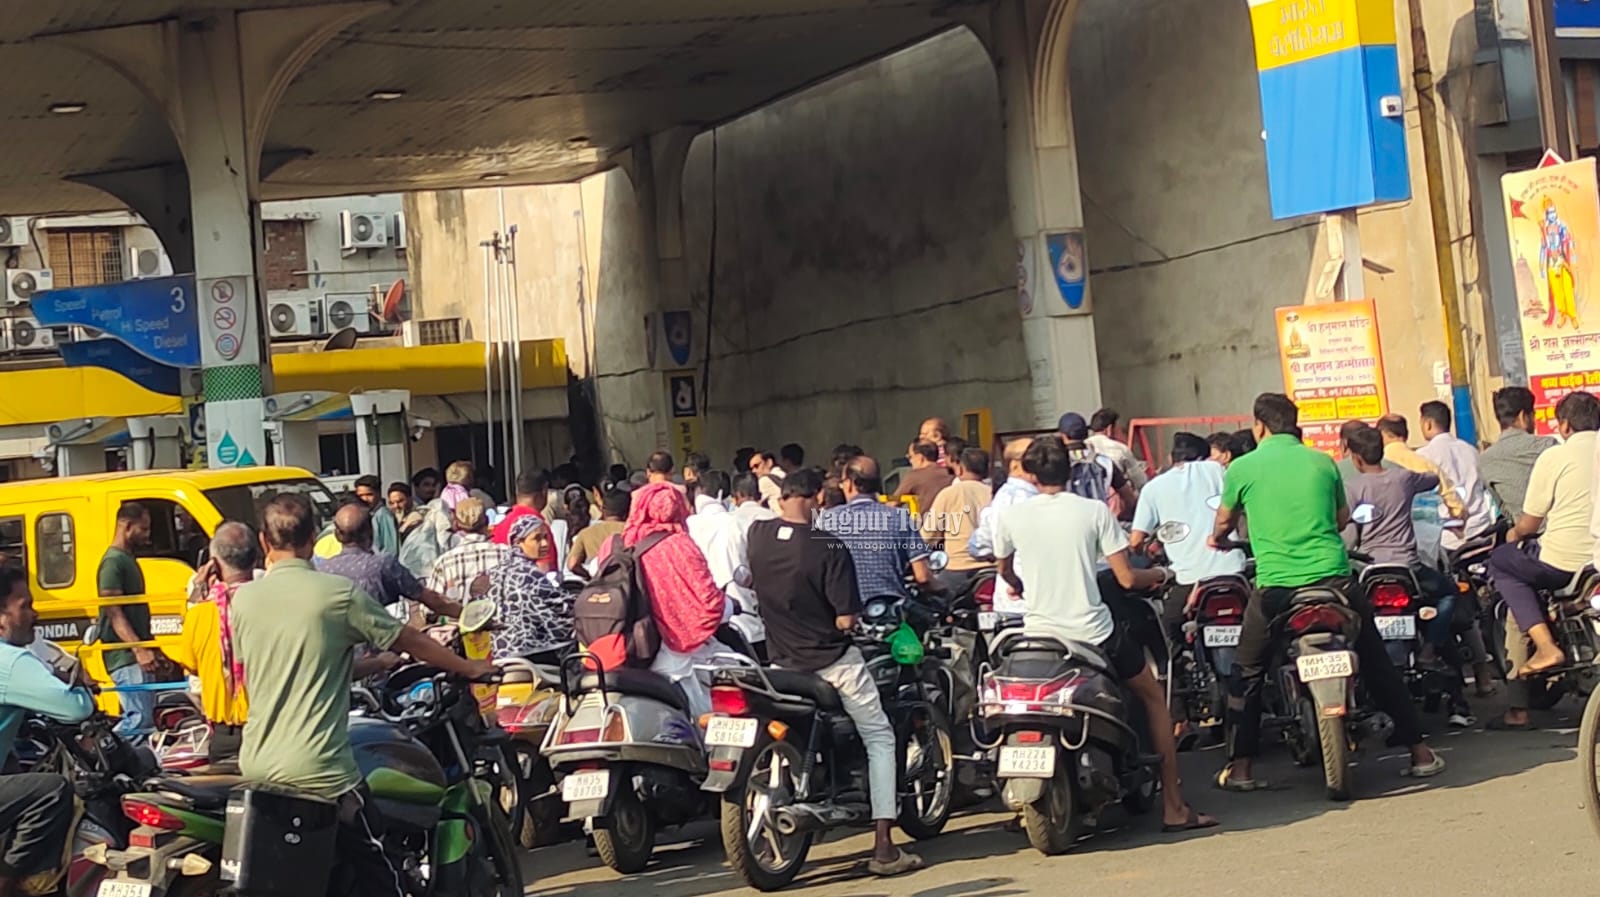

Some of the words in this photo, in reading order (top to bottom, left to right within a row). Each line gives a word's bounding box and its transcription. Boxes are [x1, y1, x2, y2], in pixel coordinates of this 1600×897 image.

[54, 298, 87, 312] Speed
[170, 286, 186, 313] 3
[91, 307, 122, 321] Petrol
[135, 317, 169, 332] Speed
[153, 334, 188, 349] Diesel
[1529, 335, 1540, 351] श्री
[33, 623, 79, 638] ONDIA
[1303, 662, 1349, 678] AM-3228
